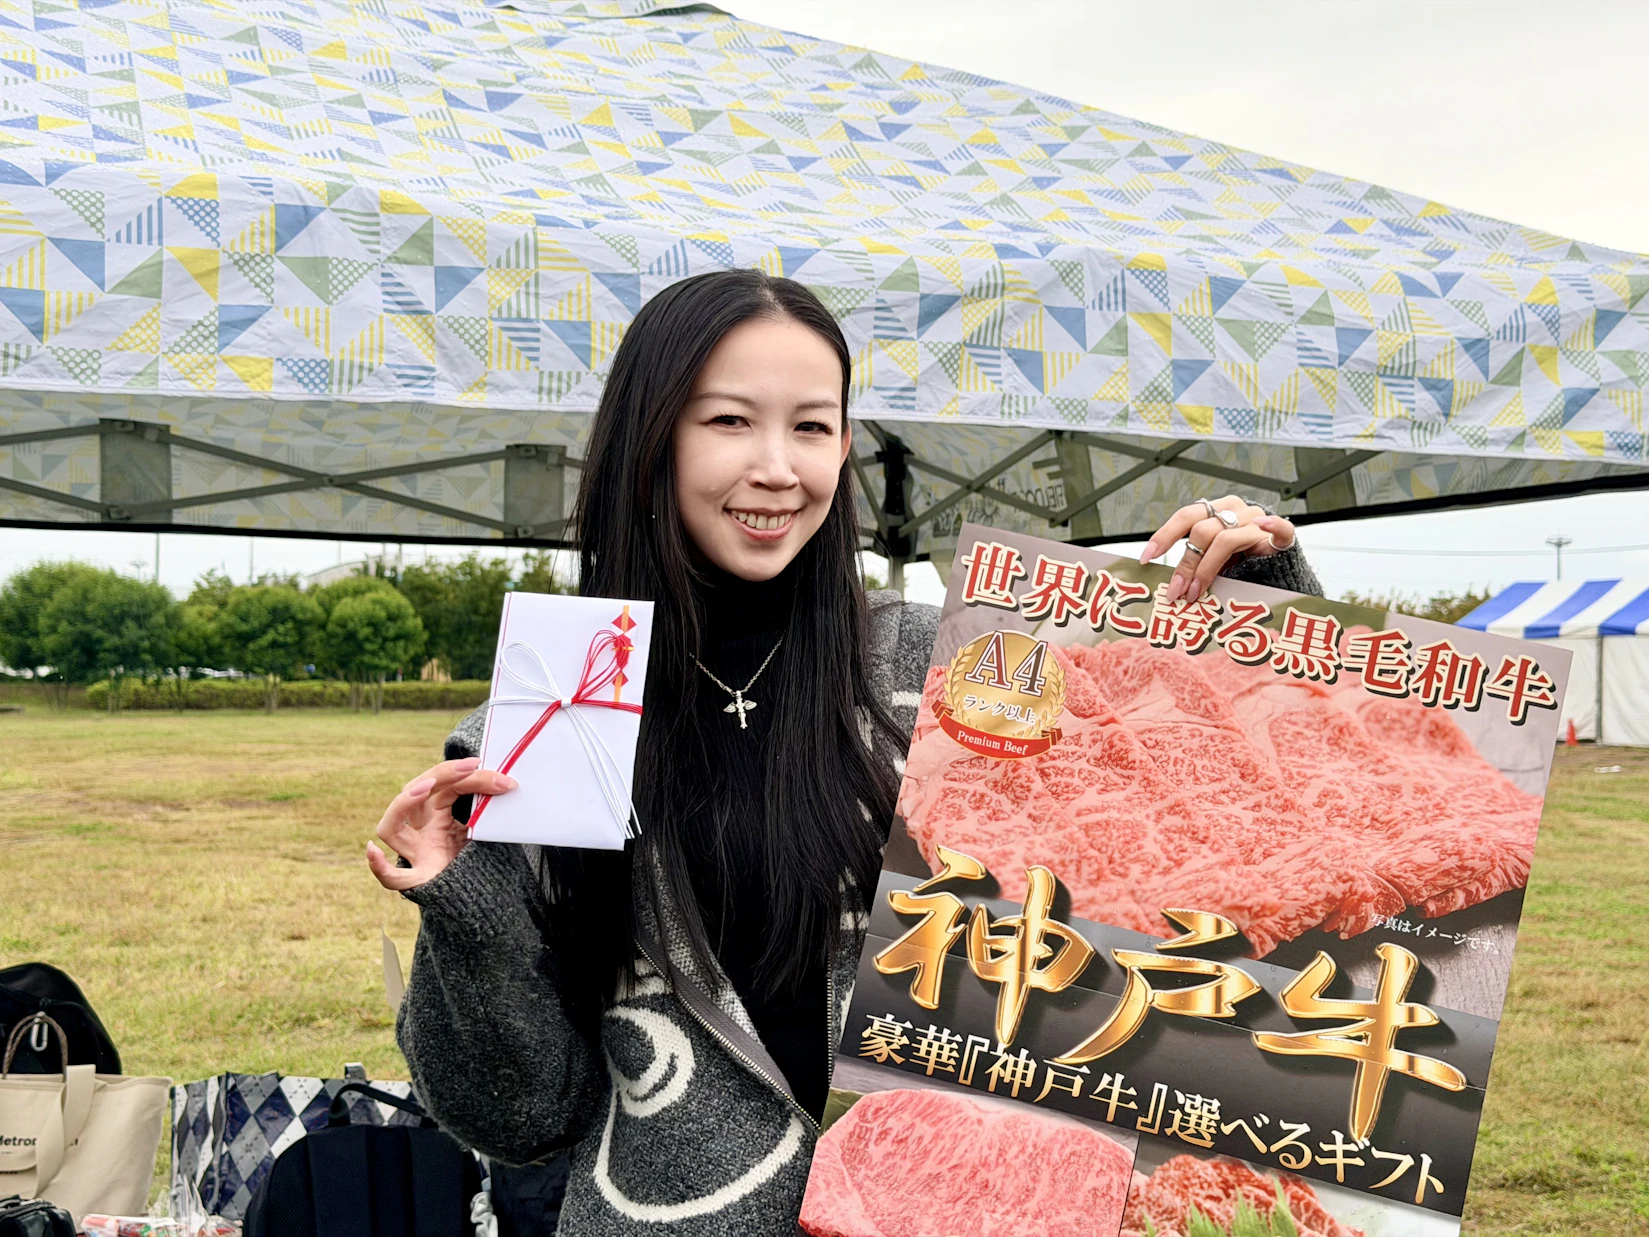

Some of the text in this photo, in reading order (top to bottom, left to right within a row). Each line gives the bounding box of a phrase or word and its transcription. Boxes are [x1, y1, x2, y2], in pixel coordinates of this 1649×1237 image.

[961, 541, 1557, 723] 世界に誇る黒毛和牛
[964, 630, 1049, 697] A4
[957, 730, 1029, 755] Premium Beef
[963, 694, 1037, 725] ランク以上
[1370, 913, 1500, 955] 写真はイメージです。
[872, 844, 1468, 1141] 神戸牛
[857, 1013, 1446, 1204] 豪華『神戸牛』選べるギフト
